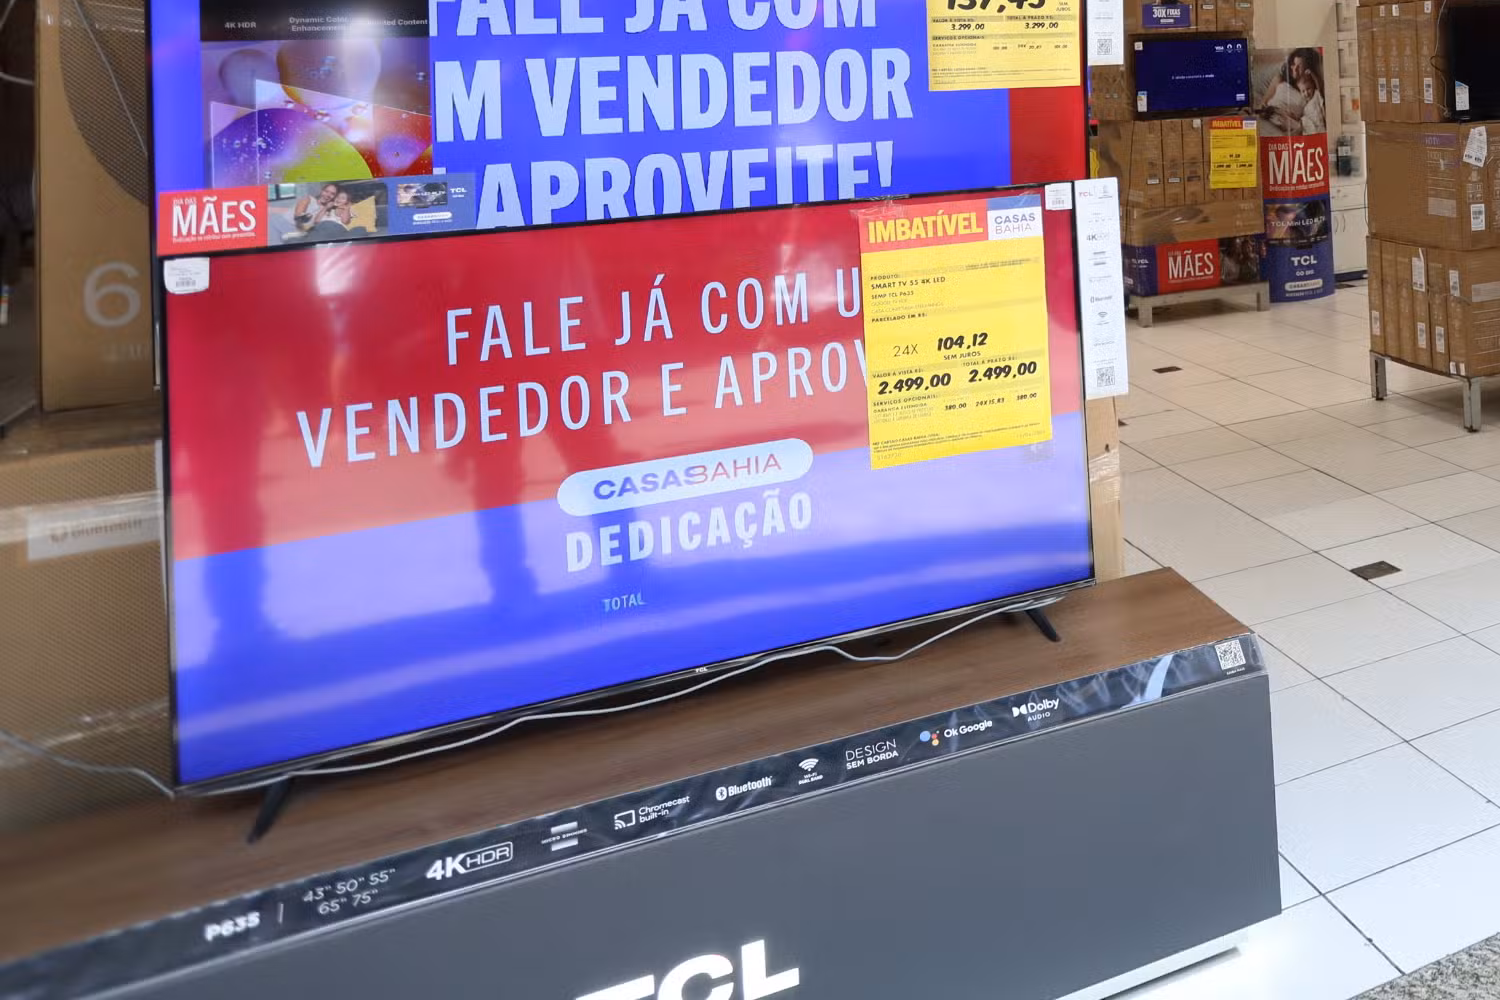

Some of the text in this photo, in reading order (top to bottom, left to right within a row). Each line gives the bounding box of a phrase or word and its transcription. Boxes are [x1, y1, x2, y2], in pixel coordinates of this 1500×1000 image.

[288, 16, 325, 25] Dynamic
[435, 60, 502, 142] M
[525, 47, 914, 137] VENDEDOR
[1268, 142, 1324, 185] MÃES
[172, 195, 256, 237] MÃES
[994, 212, 1036, 225] CASAS
[868, 209, 984, 244] IMBATÍVEL
[995, 223, 1032, 235] BAHIA
[1168, 250, 1214, 281] MÃES
[1291, 255, 1317, 267] TCL
[871, 281, 896, 290] SMART
[933, 276, 946, 284] LED
[447, 267, 861, 366] FALE JÁ COM U
[871, 314, 906, 323] PARCELADO
[893, 343, 919, 357] 24X
[937, 332, 988, 351] 104,12
[959, 351, 981, 359] JUROS
[877, 361, 1037, 396] 2.499,00 2.499,00
[297, 369, 631, 468] VENDEDOR
[661, 362, 687, 418] E
[592, 453, 783, 501] CASASBAHIA
[566, 487, 814, 573] DEDICAÇÃO
[603, 592, 645, 612] TOTAL
[1028, 698, 1059, 713] Dolby
[1028, 711, 1051, 722] AUDIO
[943, 719, 993, 738] Ok Google
[845, 738, 897, 761] DESIGN
[846, 751, 899, 770] SEM BORDA
[728, 775, 773, 797] Bluetooth
[638, 795, 690, 816] Chromecast
[639, 809, 669, 824] built-in
[541, 835, 560, 844] MICRO
[303, 868, 396, 903] 43" 50" 55"
[318, 889, 379, 915] 65" 75"
[204, 912, 260, 942] P635
